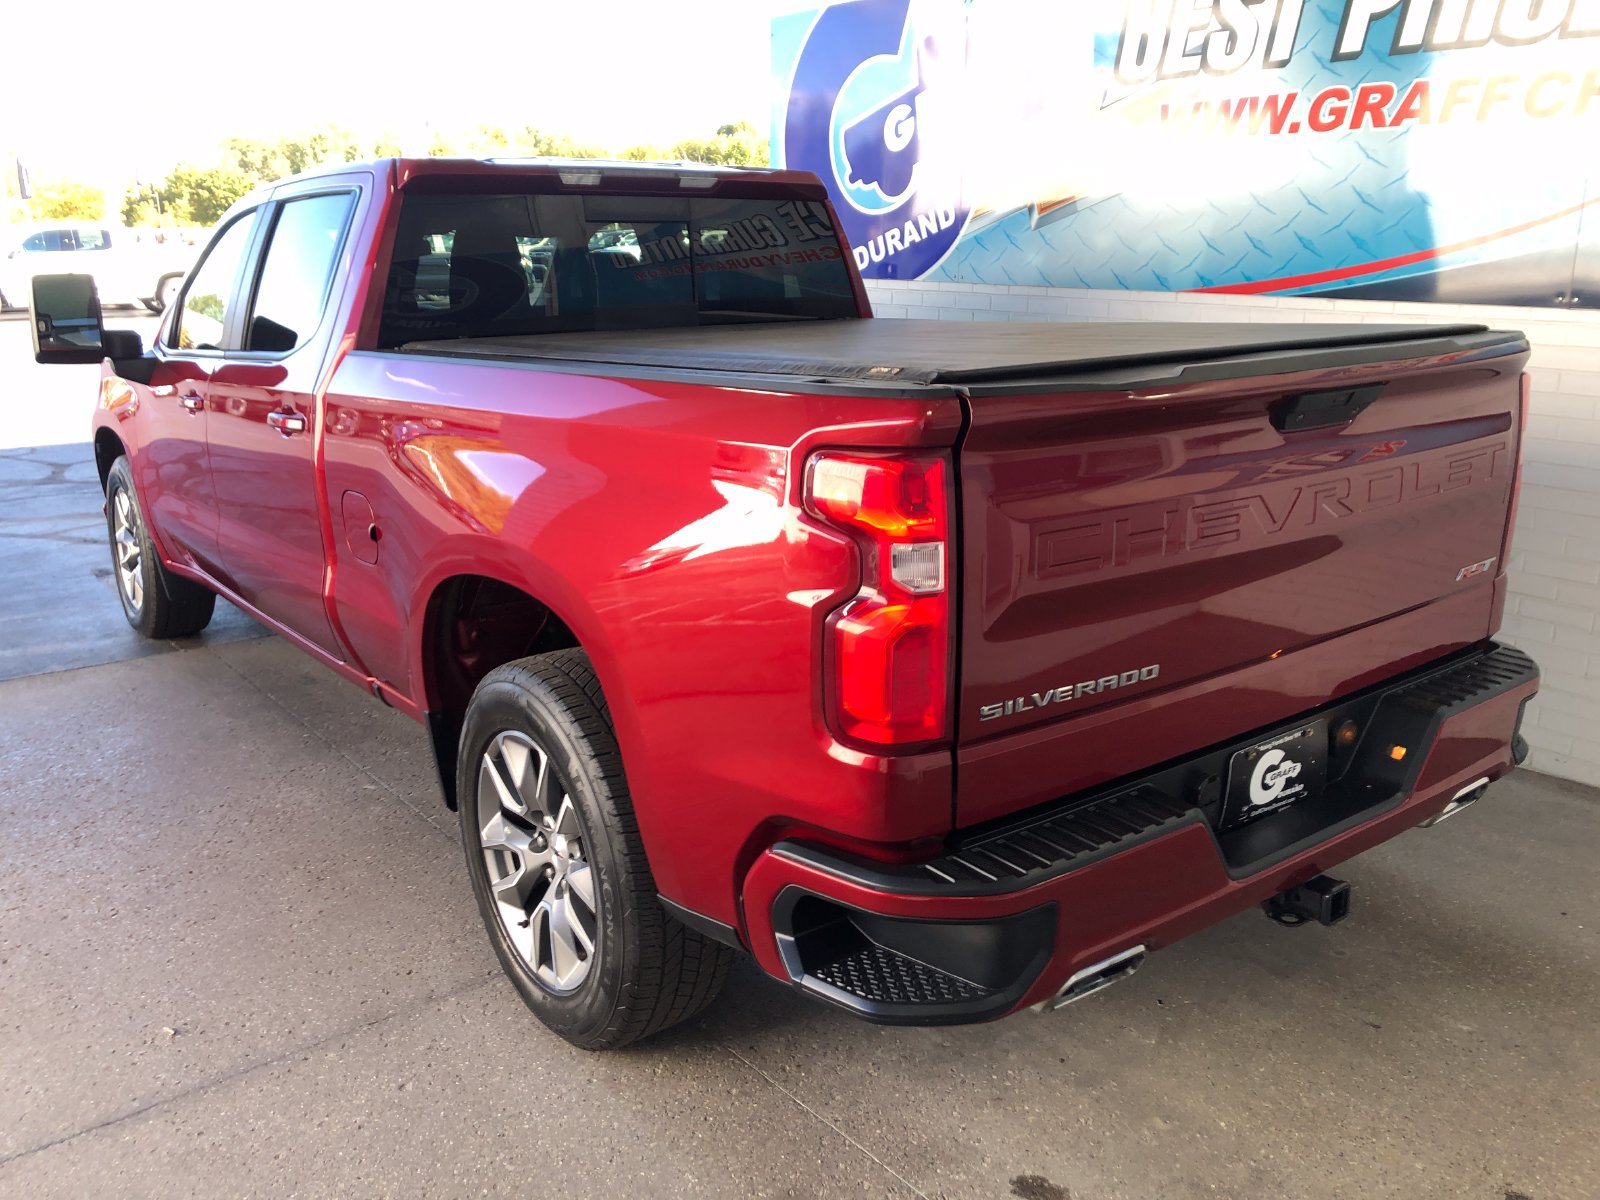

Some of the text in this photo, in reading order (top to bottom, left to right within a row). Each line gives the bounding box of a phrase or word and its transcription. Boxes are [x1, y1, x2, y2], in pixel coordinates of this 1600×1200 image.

[1330, 0, 1600, 62] PRIC
[853, 205, 956, 271] DURAND
[1034, 442, 1506, 580] CHEVROLET
[979, 664, 1160, 721] SILVERADO
[1270, 765, 1298, 781] GRAFF
